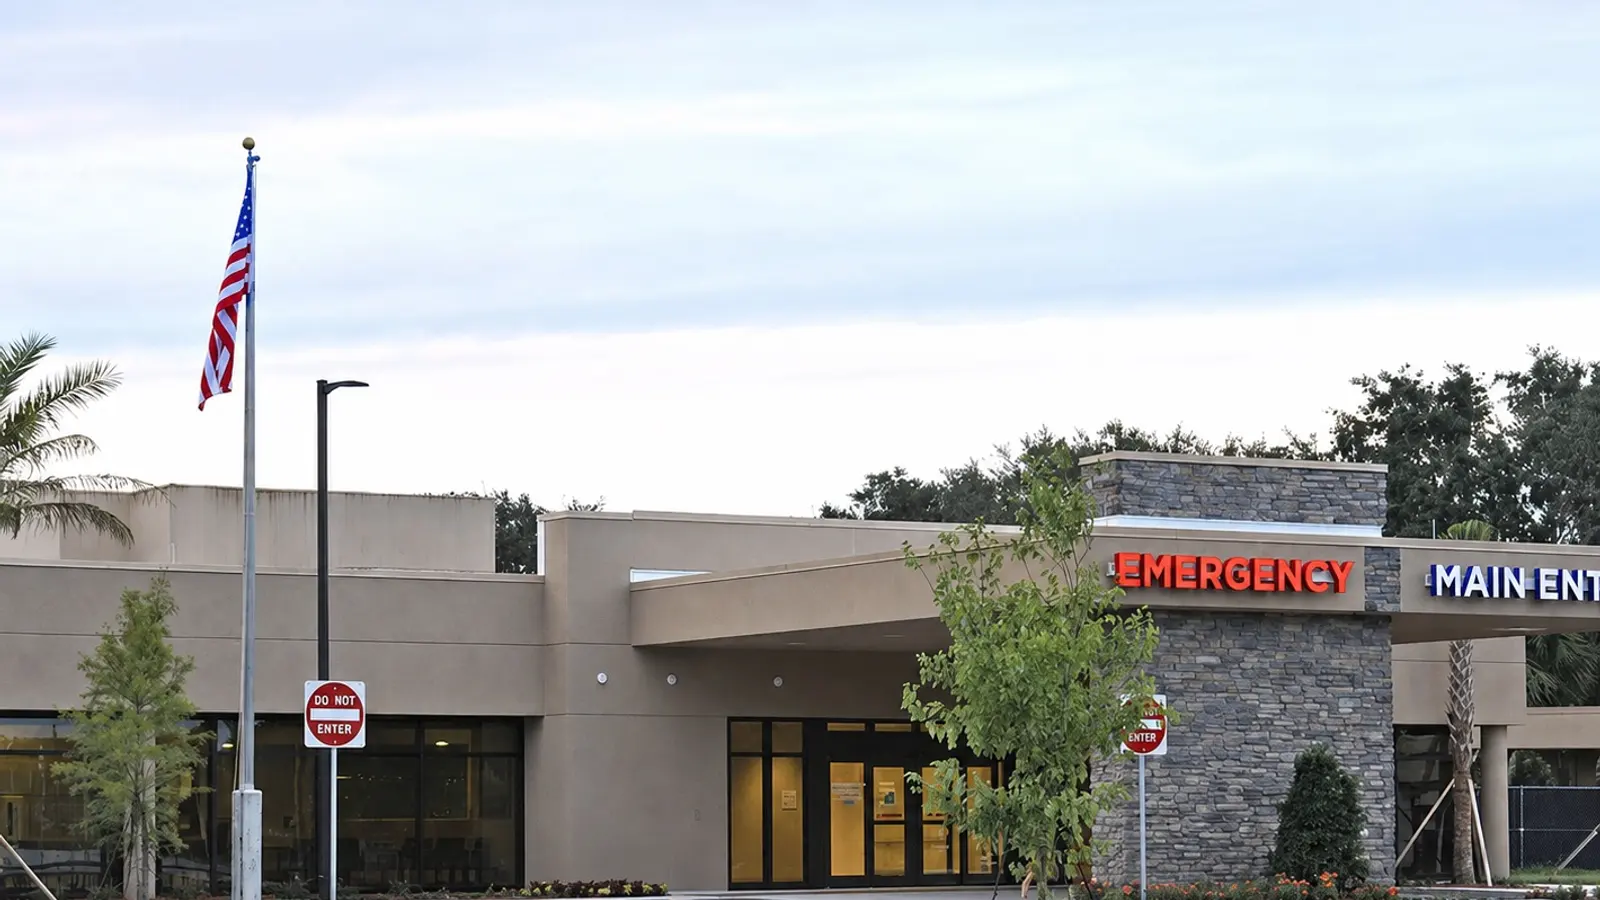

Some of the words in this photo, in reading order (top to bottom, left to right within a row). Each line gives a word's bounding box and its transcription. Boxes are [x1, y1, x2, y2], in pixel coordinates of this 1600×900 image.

[1114, 552, 1355, 594] EMERGENCY
[1430, 564, 1526, 599] MAIN
[314, 694, 330, 706] DO
[334, 695, 356, 706] NOT
[317, 723, 352, 735] ENTER
[1128, 732, 1157, 743] ENTER
